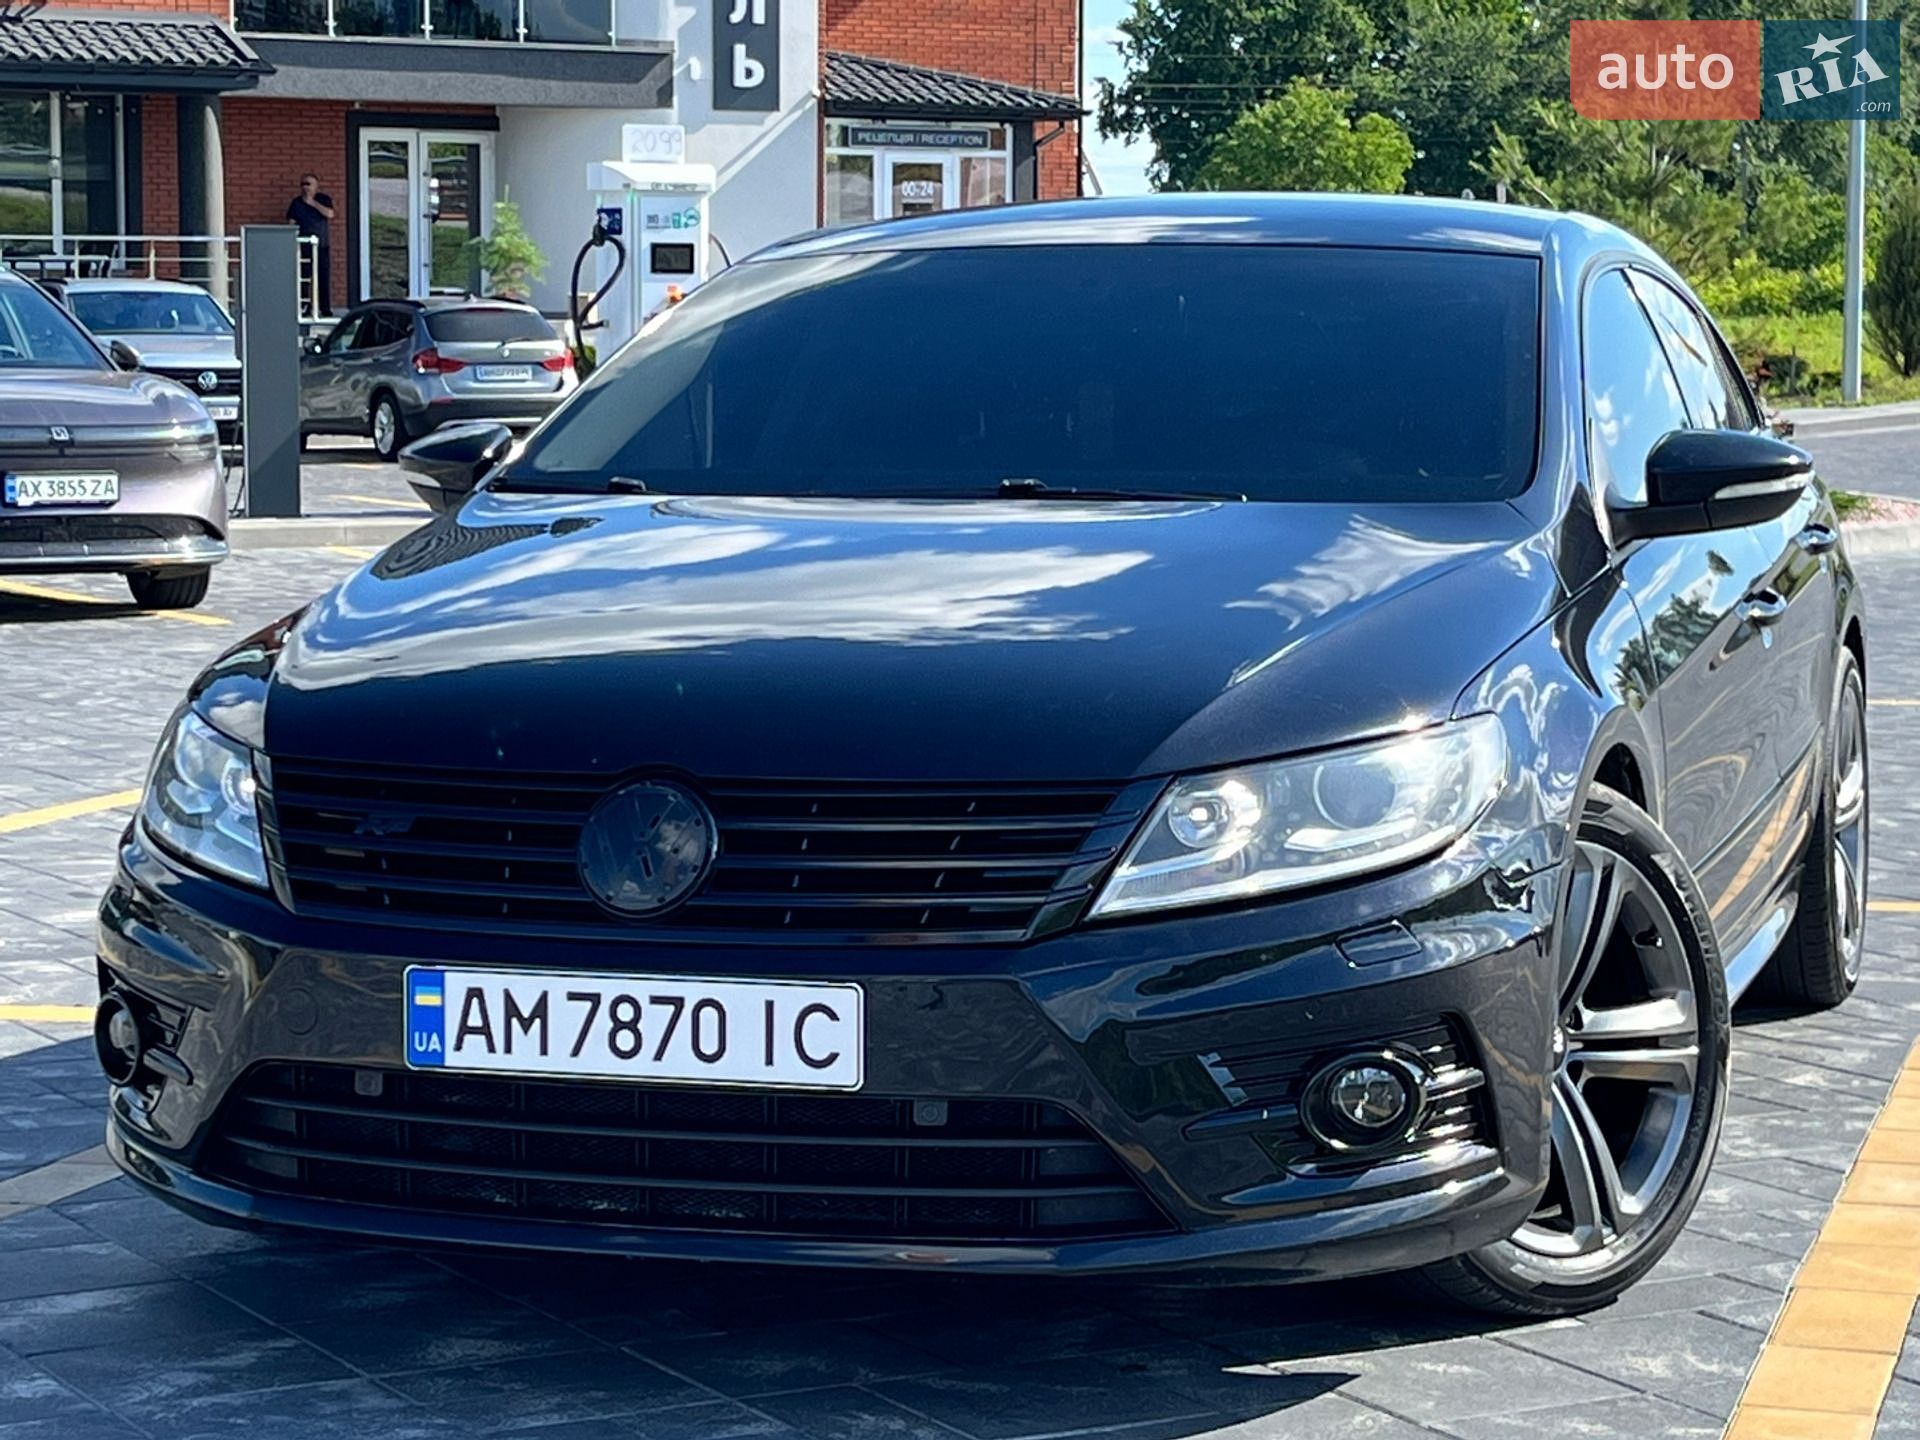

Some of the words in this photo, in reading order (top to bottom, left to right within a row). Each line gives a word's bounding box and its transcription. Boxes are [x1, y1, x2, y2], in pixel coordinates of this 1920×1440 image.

[921, 133, 983, 146] RECEPTION
[901, 181, 934, 197] 00-24
[90, 479, 115, 497] ZA
[566, 991, 727, 1064] 7870
[765, 1000, 841, 1070] IC
[414, 1030, 442, 1053] UA
